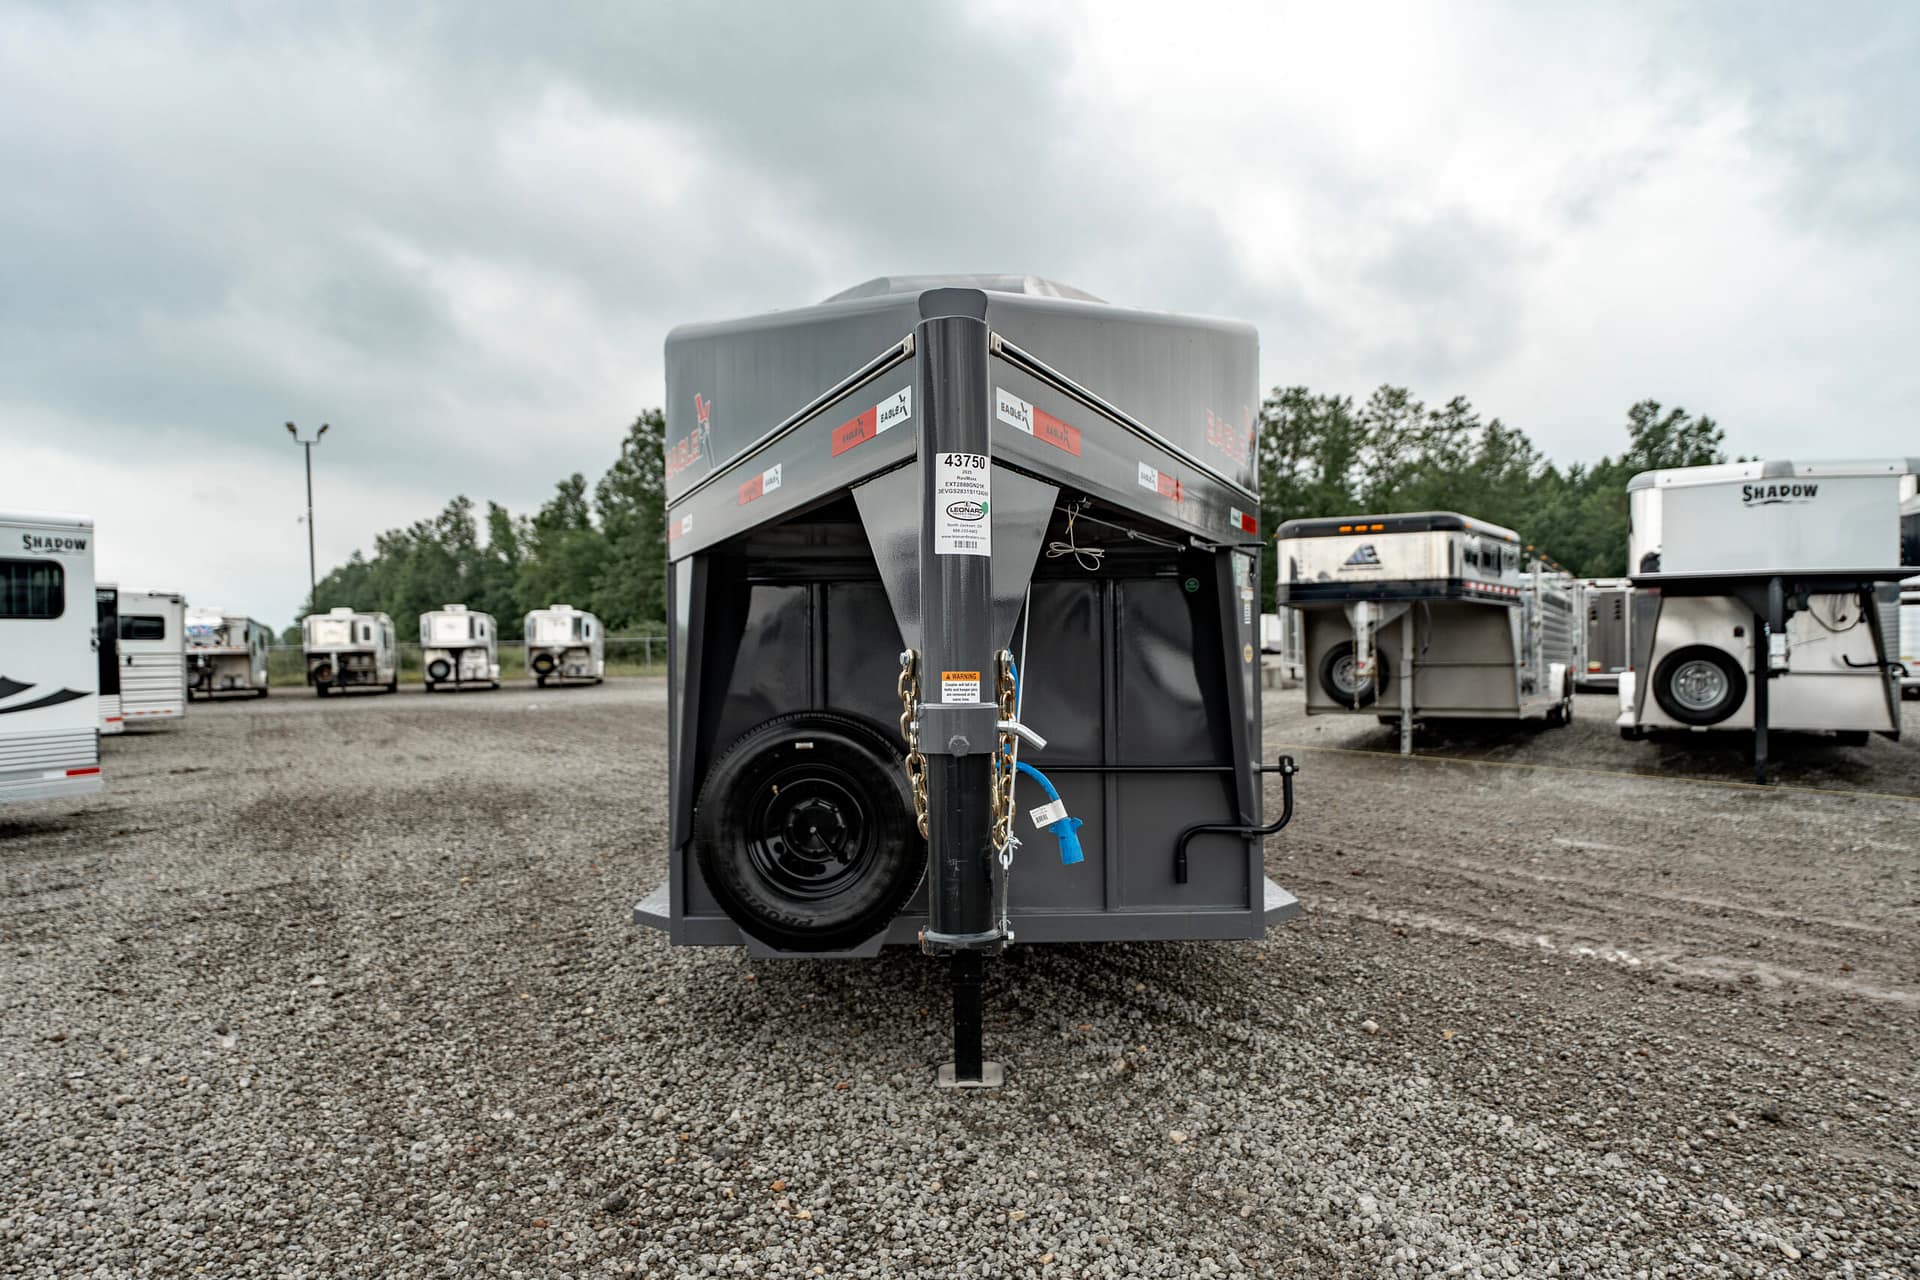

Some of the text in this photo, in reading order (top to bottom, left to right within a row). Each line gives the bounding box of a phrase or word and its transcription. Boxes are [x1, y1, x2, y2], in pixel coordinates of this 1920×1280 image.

[944, 454, 985, 469] 43750
[1742, 484, 1818, 502] SHADOW
[22, 534, 87, 551] SHADOW
